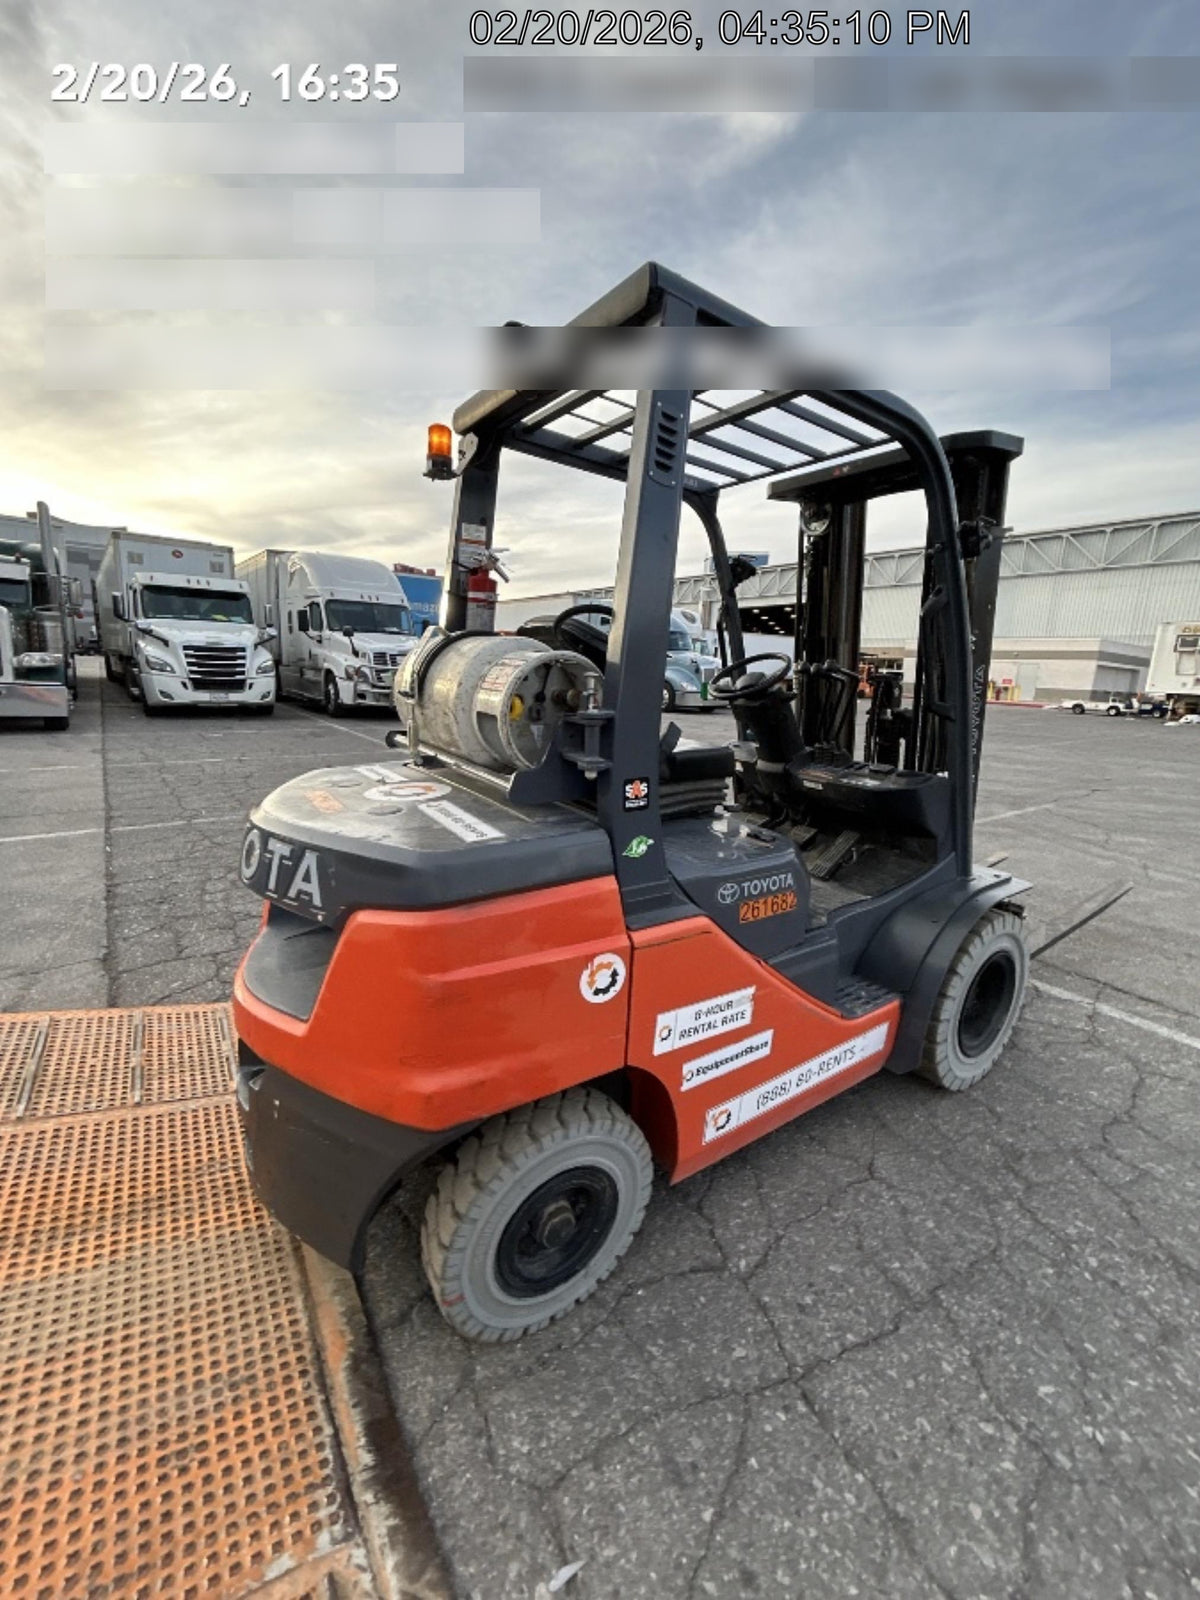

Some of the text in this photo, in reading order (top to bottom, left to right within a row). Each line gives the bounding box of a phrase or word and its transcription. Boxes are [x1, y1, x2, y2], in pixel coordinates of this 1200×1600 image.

[741, 873, 794, 897] TOYOTA
[679, 1009, 748, 1041] RENTAL RATE
